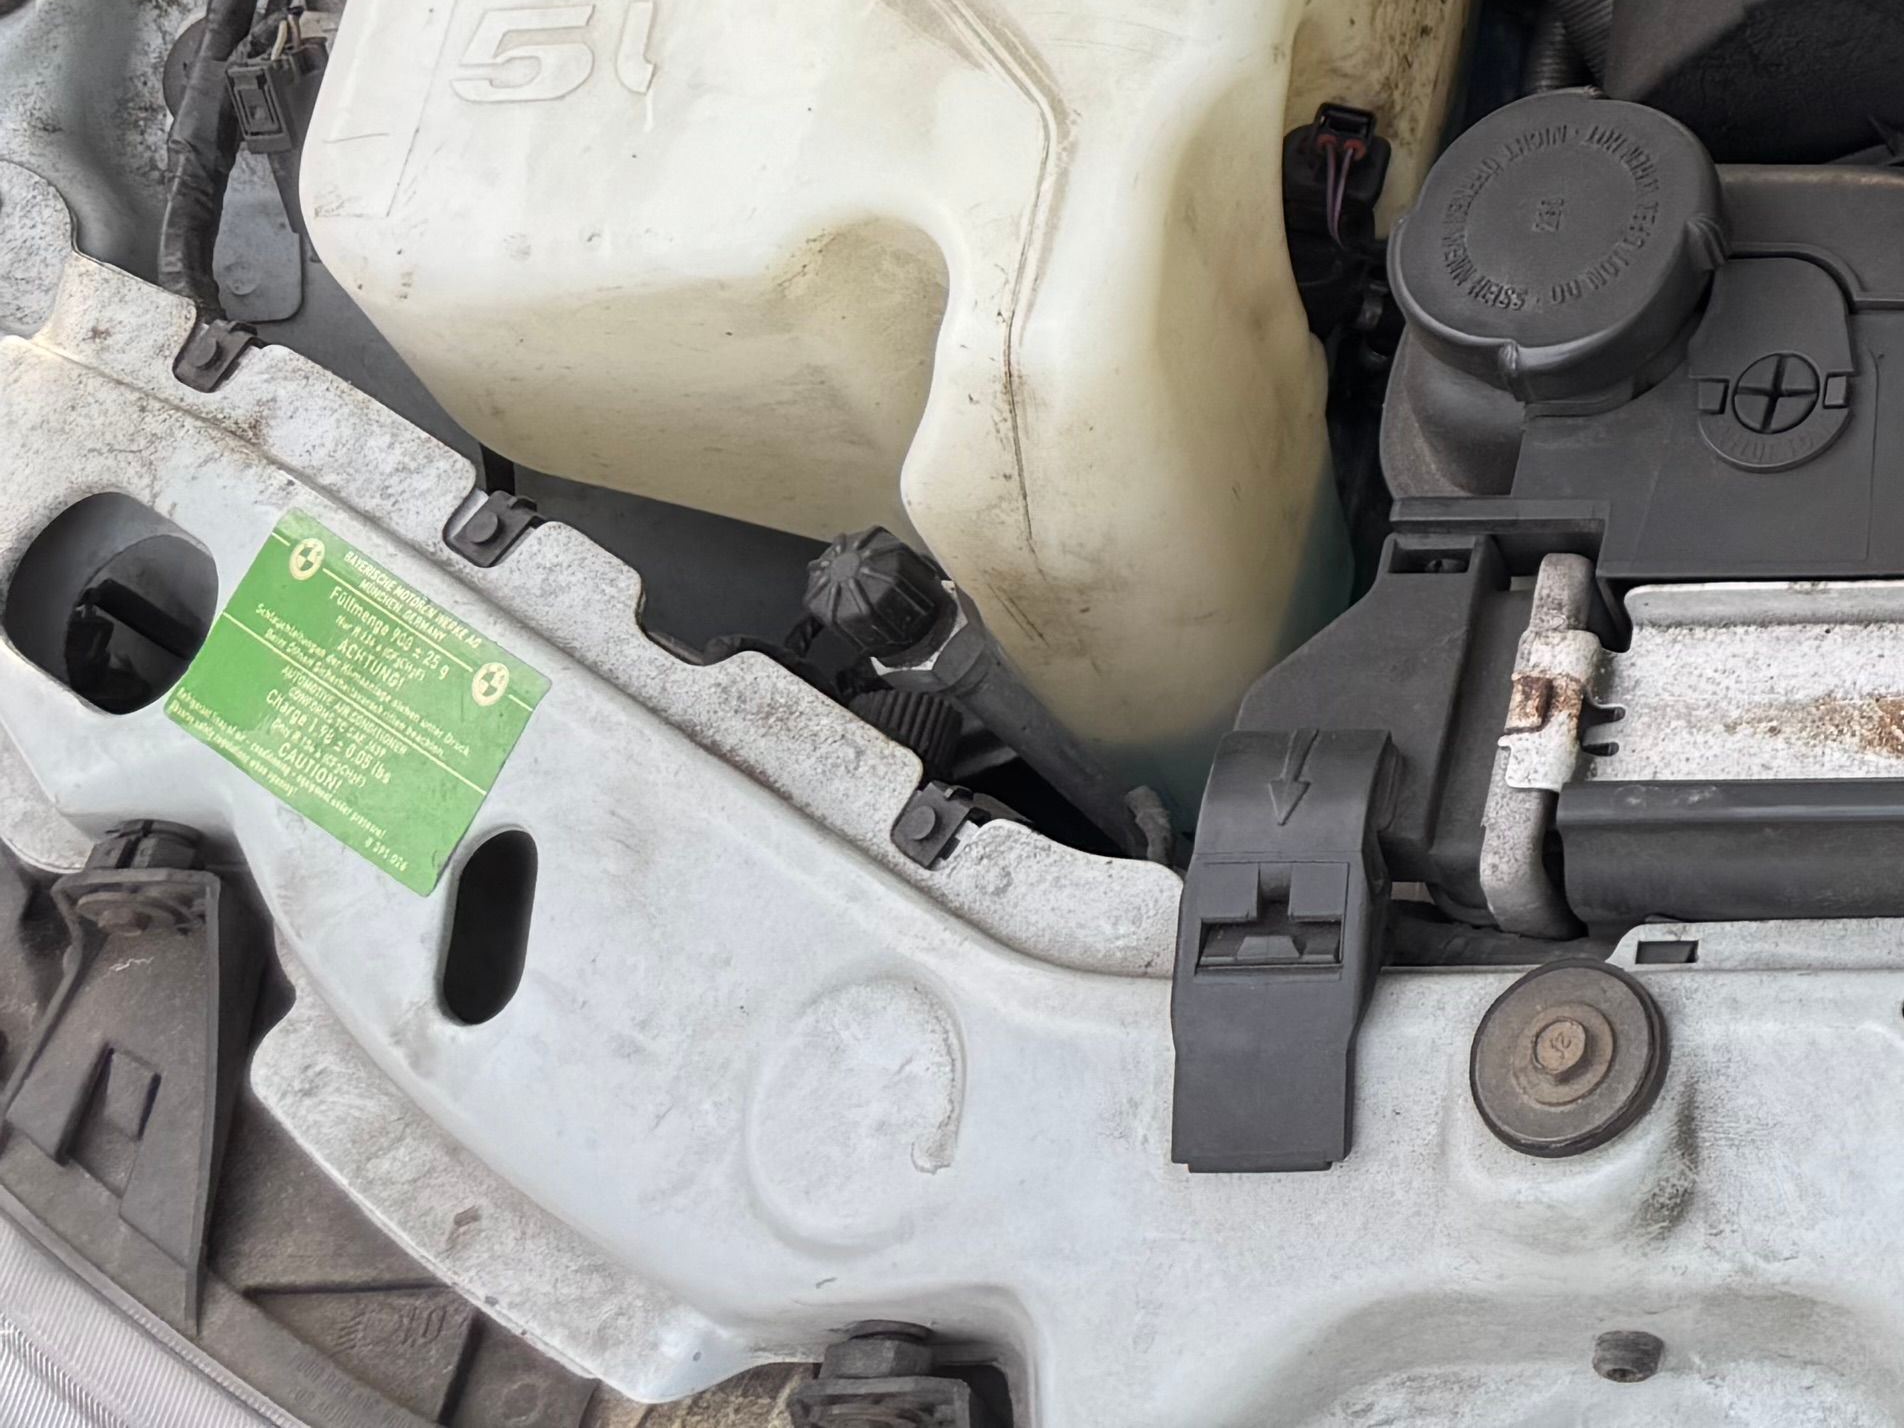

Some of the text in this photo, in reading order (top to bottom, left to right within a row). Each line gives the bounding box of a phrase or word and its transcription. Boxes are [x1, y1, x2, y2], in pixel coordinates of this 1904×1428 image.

[1464, 273, 1529, 314] HEISS
[342, 550, 397, 593] BAYERISCHE
[393, 584, 437, 619] MOTOREN
[464, 632, 481, 650] AG
[327, 585, 392, 637] Füllmenge
[421, 650, 441, 670] 25
[402, 608, 446, 643] GERMANY
[336, 637, 406, 692] ACHTUNG!
[262, 688, 310, 729] Charge
[277, 740, 344, 793] CAUTION!
[442, 731, 472, 757] Druck
